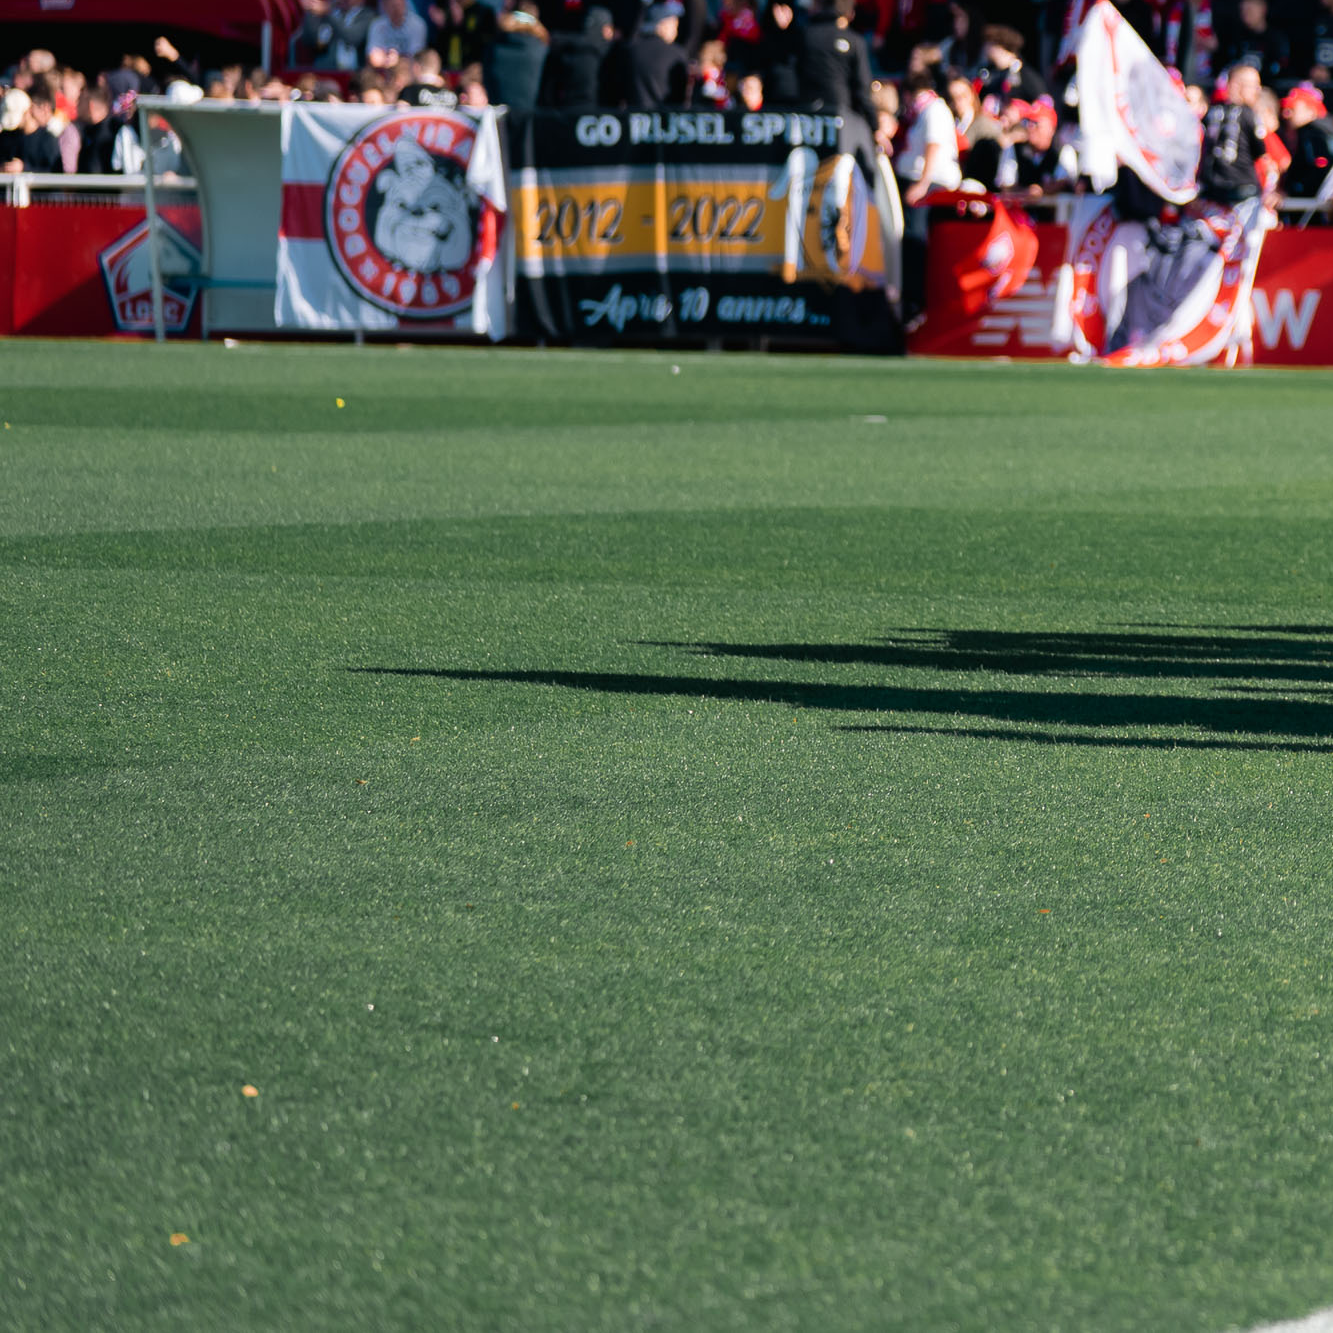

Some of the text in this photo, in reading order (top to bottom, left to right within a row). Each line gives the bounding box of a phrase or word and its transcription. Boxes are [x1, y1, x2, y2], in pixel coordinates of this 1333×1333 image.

[576, 115, 622, 146] GO
[536, 195, 625, 248] 2012
[670, 196, 765, 245] 2022
